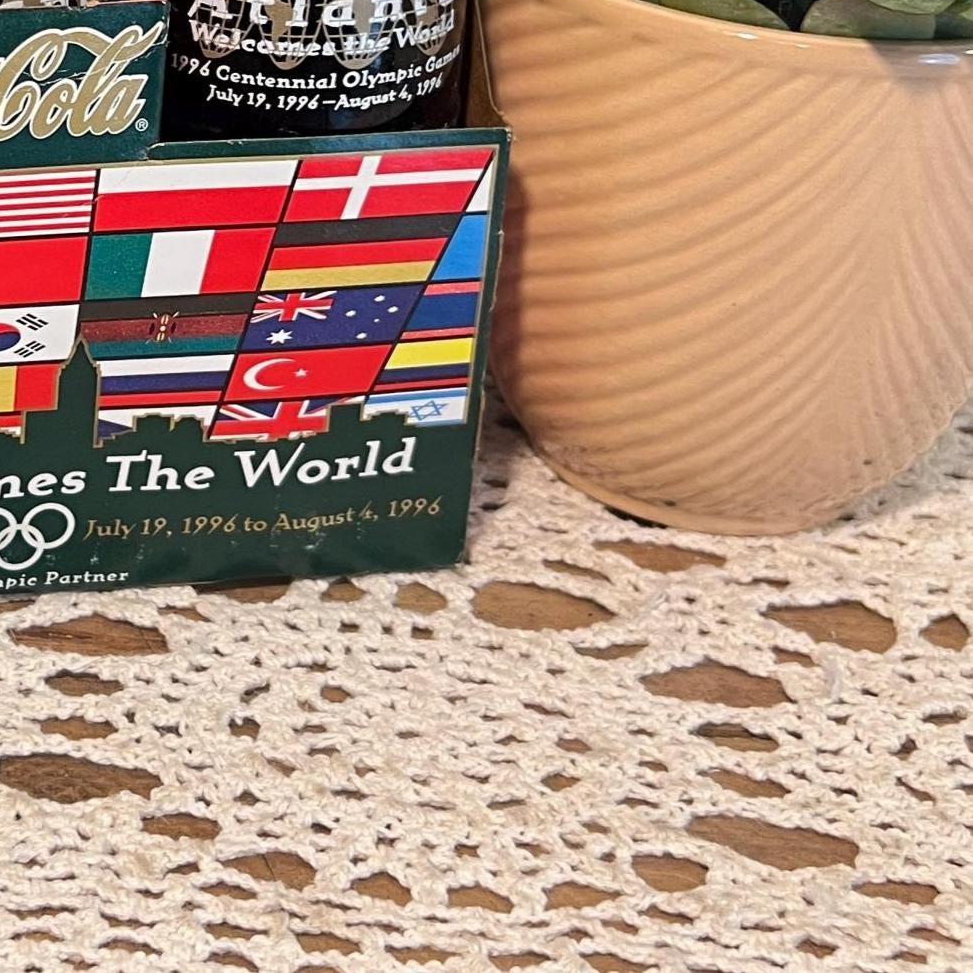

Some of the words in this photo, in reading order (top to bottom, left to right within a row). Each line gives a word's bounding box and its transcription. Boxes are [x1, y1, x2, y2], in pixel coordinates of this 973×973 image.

[189, 19, 336, 57] Welcomes
[343, 32, 390, 55] the
[394, 9, 455, 49] World
[171, 53, 211, 77] 1996
[216, 65, 337, 90] Centennial
[343, 62, 423, 89] Olympic
[207, 84, 243, 107] July
[248, 92, 272, 110] 19,
[278, 94, 321, 112] 1996
[398, 84, 413, 103] 4,
[416, 73, 443, 97] 1996
[106, 450, 215, 493] The
[234, 436, 417, 488] World
[83, 519, 133, 541] July
[140, 517, 173, 538] 19,
[181, 513, 239, 535] 1996
[244, 514, 267, 532] to
[275, 504, 355, 533] August
[358, 501, 379, 522] 4,
[387, 495, 443, 518] 1996
[44, 570, 129, 586] Partner
